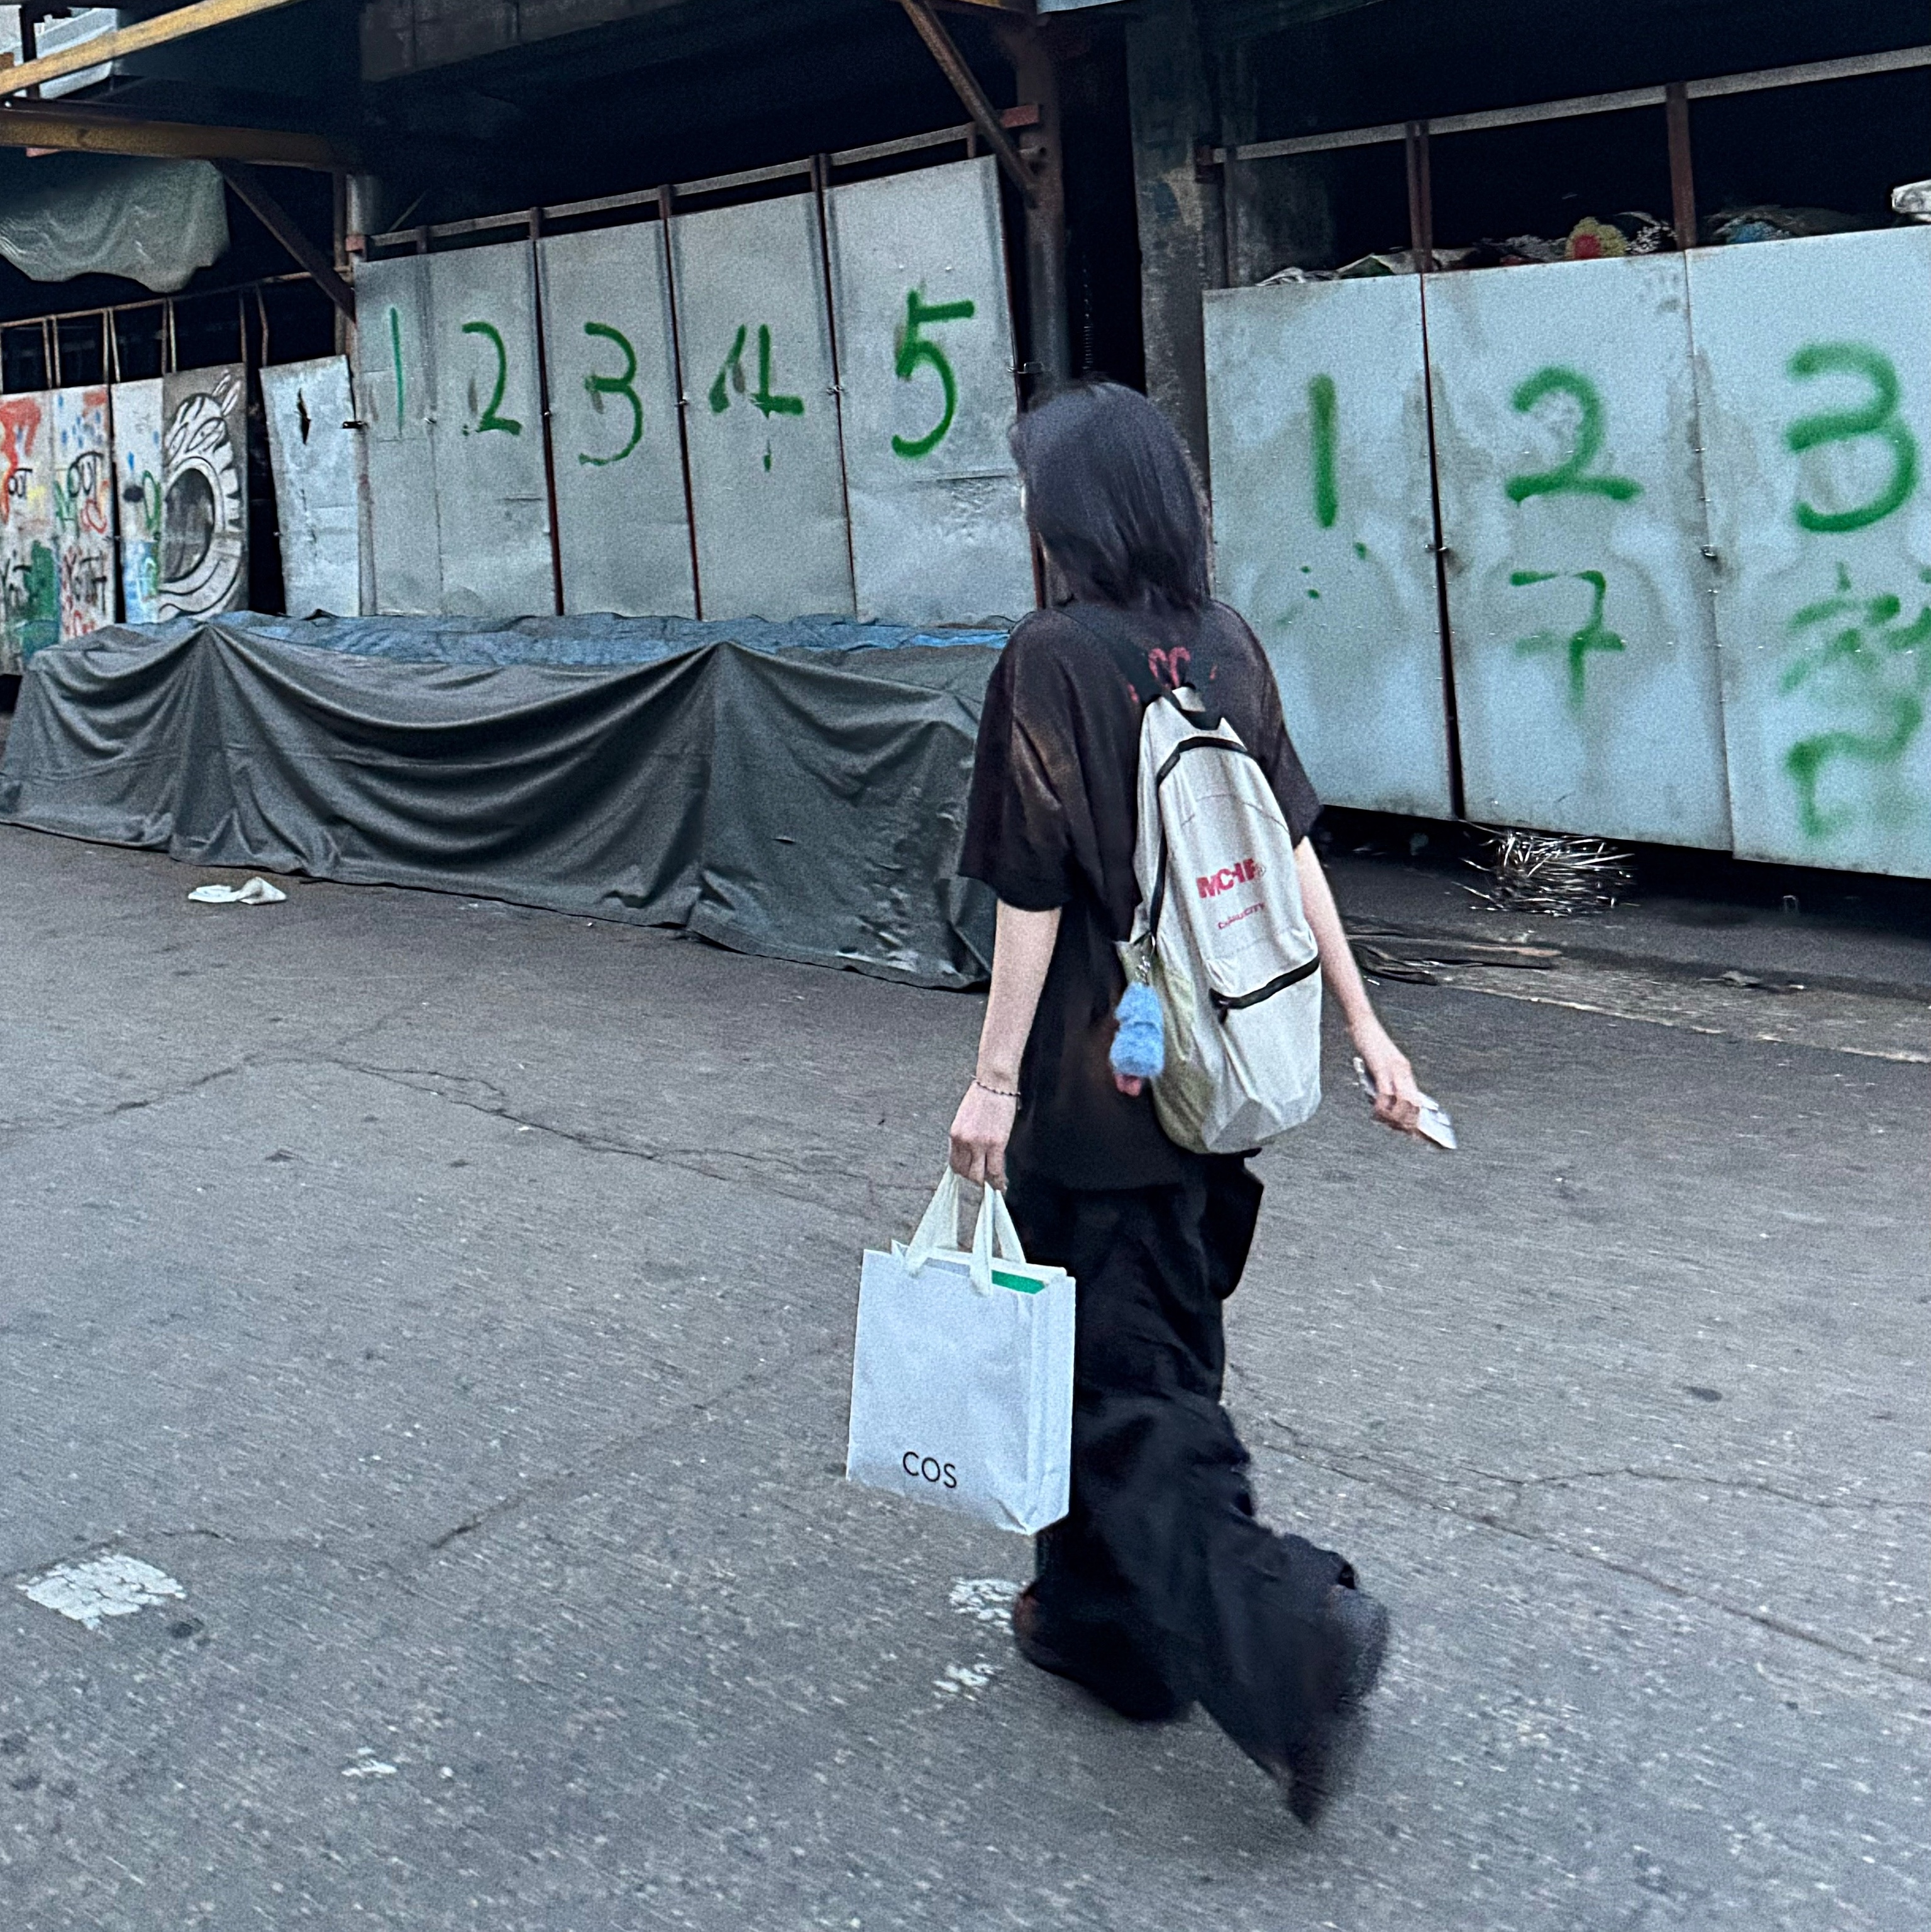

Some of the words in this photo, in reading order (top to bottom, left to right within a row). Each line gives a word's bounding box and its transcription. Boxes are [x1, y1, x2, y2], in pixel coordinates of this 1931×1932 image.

[389, 306, 405, 438] 1
[462, 321, 523, 436] 2
[578, 321, 643, 466] 3
[708, 323, 805, 419] 4
[890, 289, 976, 459] 5
[1305, 372, 1339, 529] 1
[1505, 363, 1642, 504] 2
[1784, 343, 1921, 533] 3
[1510, 568, 1625, 717] 7
[902, 1451, 958, 1489] COS
